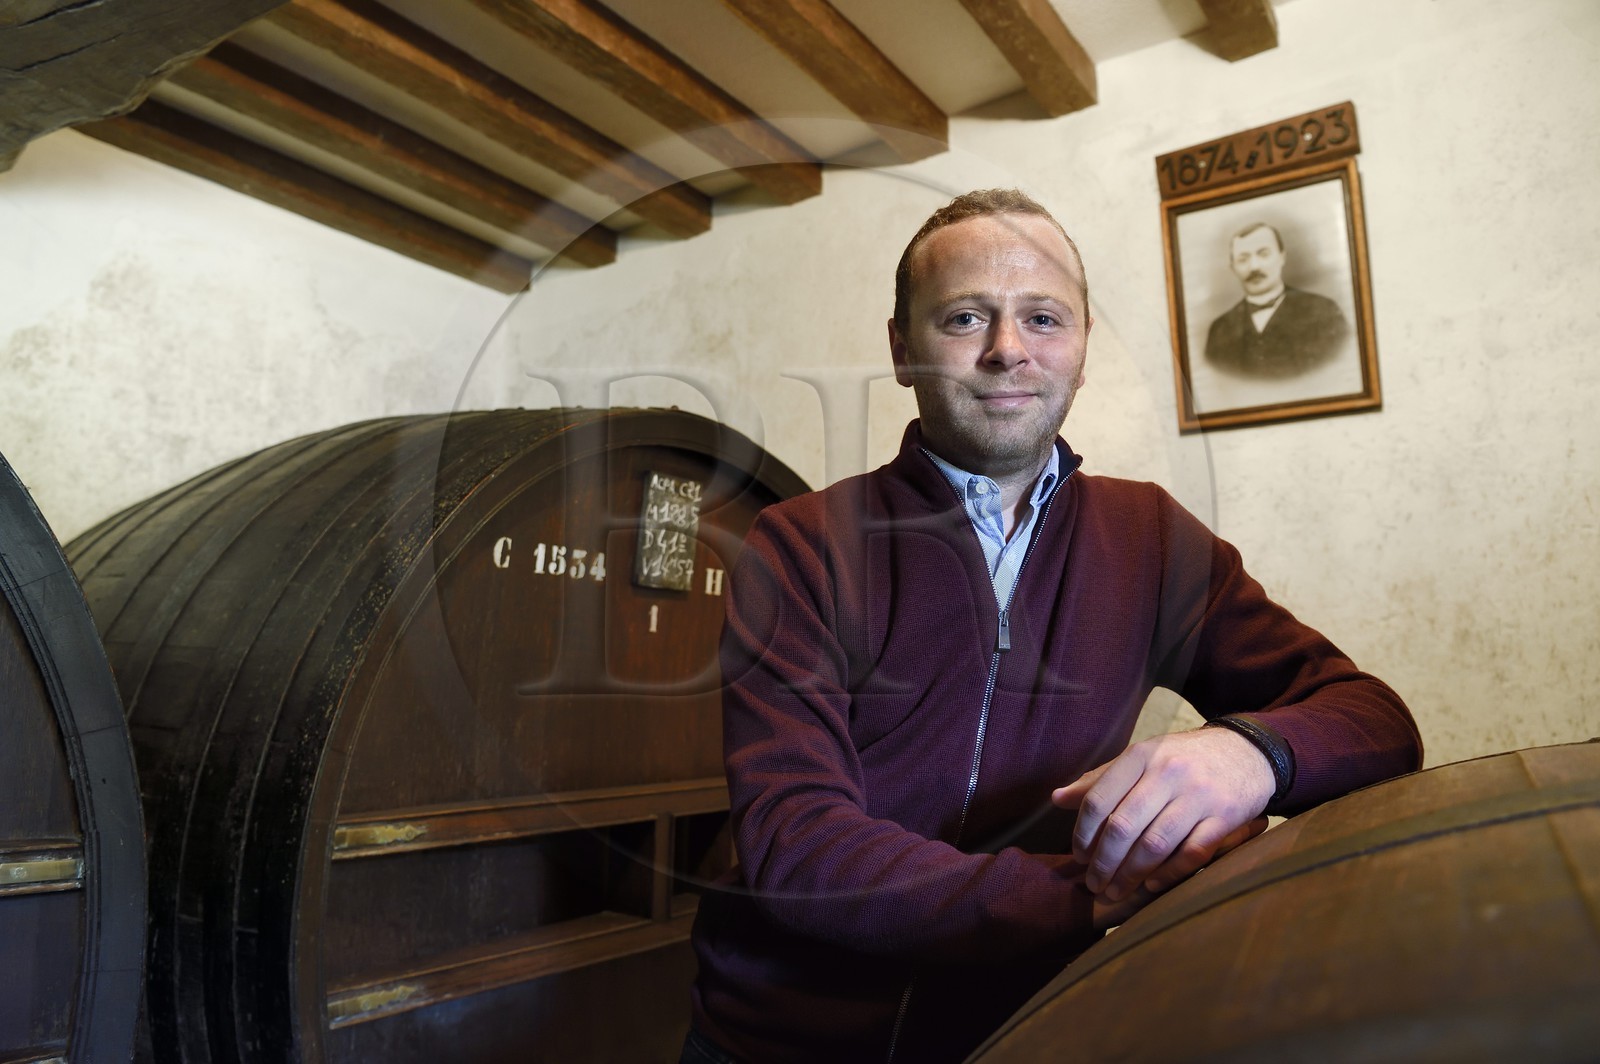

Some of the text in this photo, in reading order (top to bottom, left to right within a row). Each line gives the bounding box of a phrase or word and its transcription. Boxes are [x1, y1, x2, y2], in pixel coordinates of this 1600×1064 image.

[1160, 108, 1351, 191] 1874 1923
[493, 536, 513, 569] C
[704, 567, 724, 597] H
